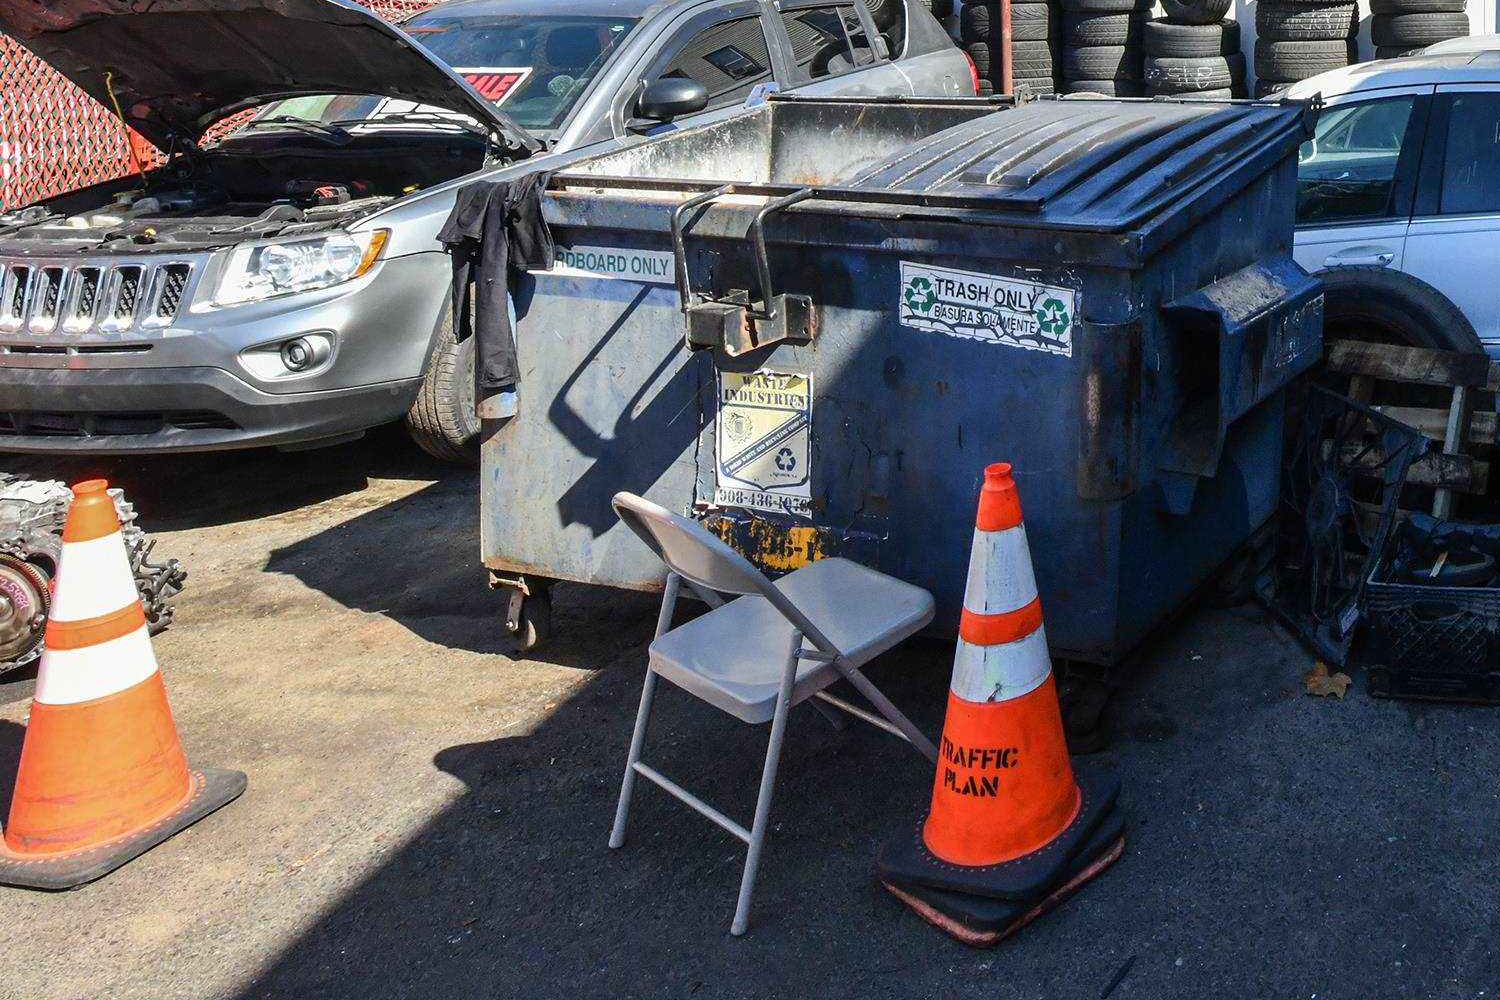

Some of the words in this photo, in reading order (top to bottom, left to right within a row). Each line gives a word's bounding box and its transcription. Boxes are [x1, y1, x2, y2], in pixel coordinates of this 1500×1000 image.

[631, 256, 669, 276] ONLY
[935, 278, 989, 302] TRASH
[994, 287, 1039, 310] ONLY
[934, 304, 974, 325] BASURA
[976, 310, 1036, 334] SOLAMENTE
[742, 375, 786, 390] WASTE
[724, 388, 805, 408] INDUSTRIES
[943, 736, 1019, 770] TRAFFIC
[945, 767, 999, 797] PLAN
